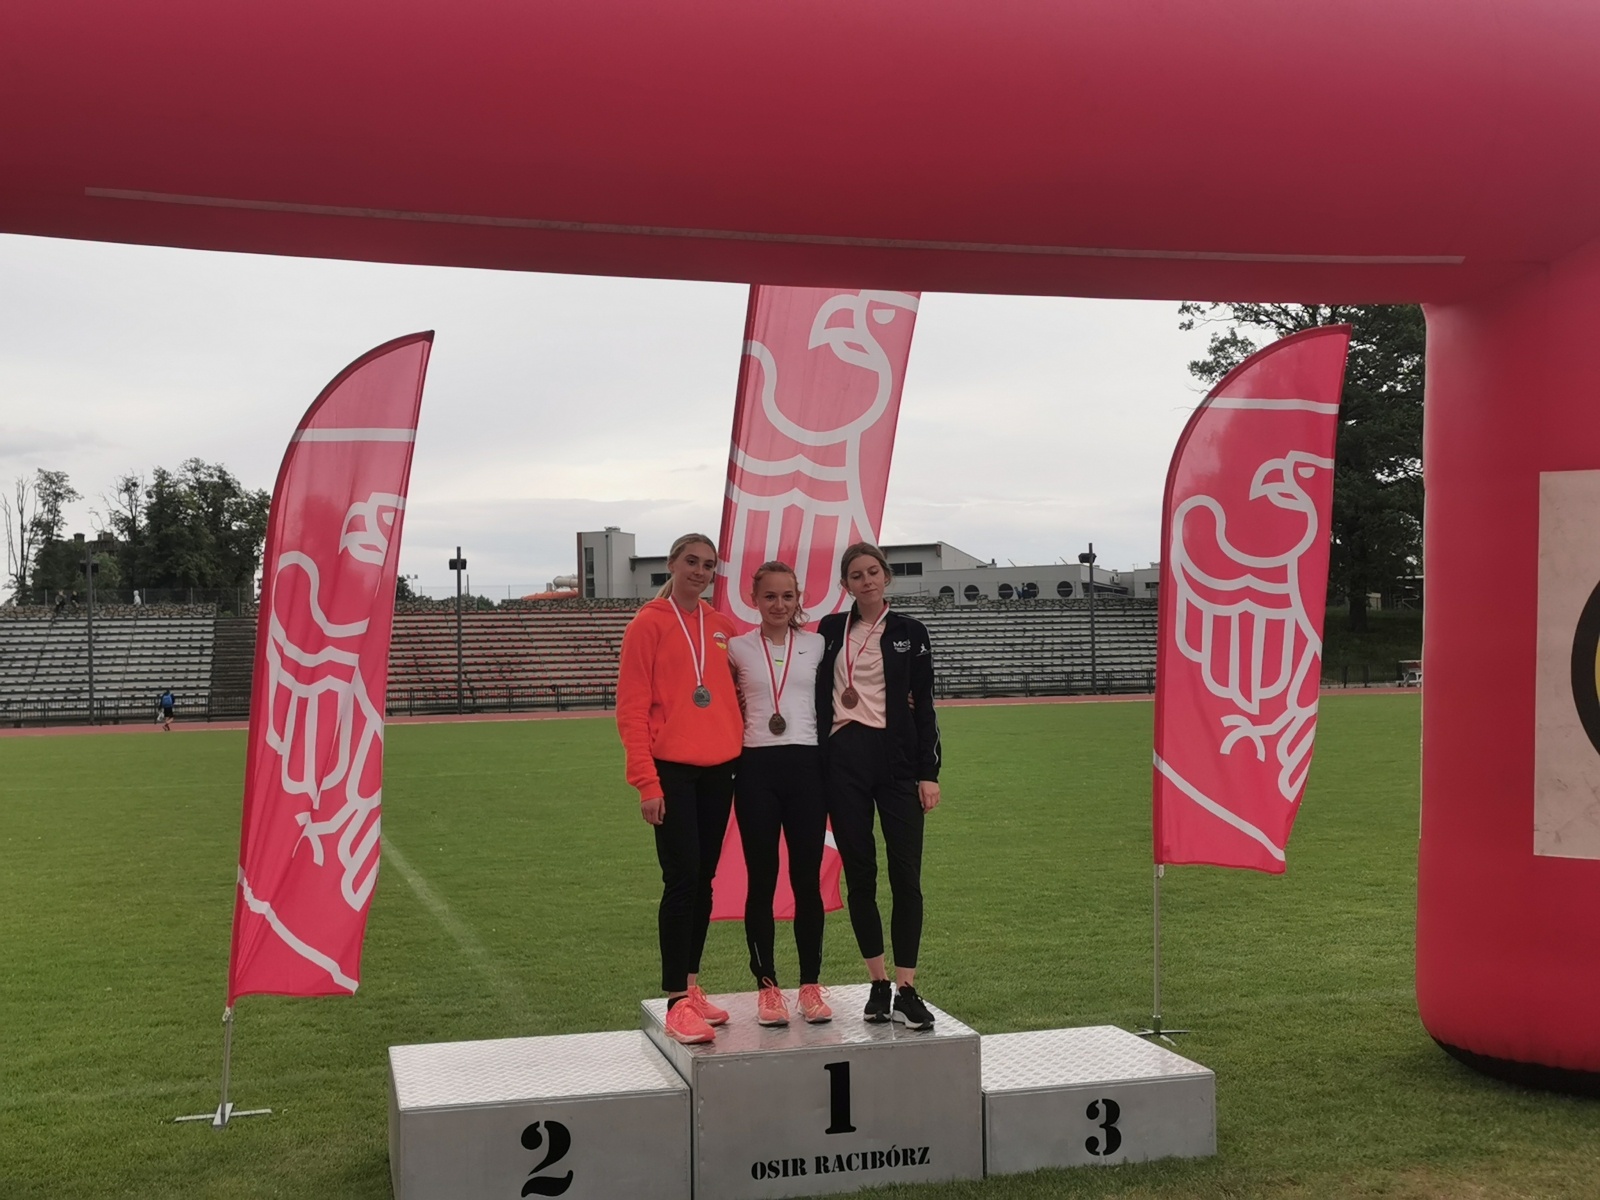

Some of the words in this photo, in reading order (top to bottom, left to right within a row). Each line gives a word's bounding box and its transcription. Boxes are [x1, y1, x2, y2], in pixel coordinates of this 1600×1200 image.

[824, 1061, 857, 1134] 1
[1085, 1099, 1122, 1156] 3
[521, 1120, 573, 1197] 2
[751, 1158, 807, 1180] OSIR
[815, 1145, 930, 1175] RACIBÓRZ
